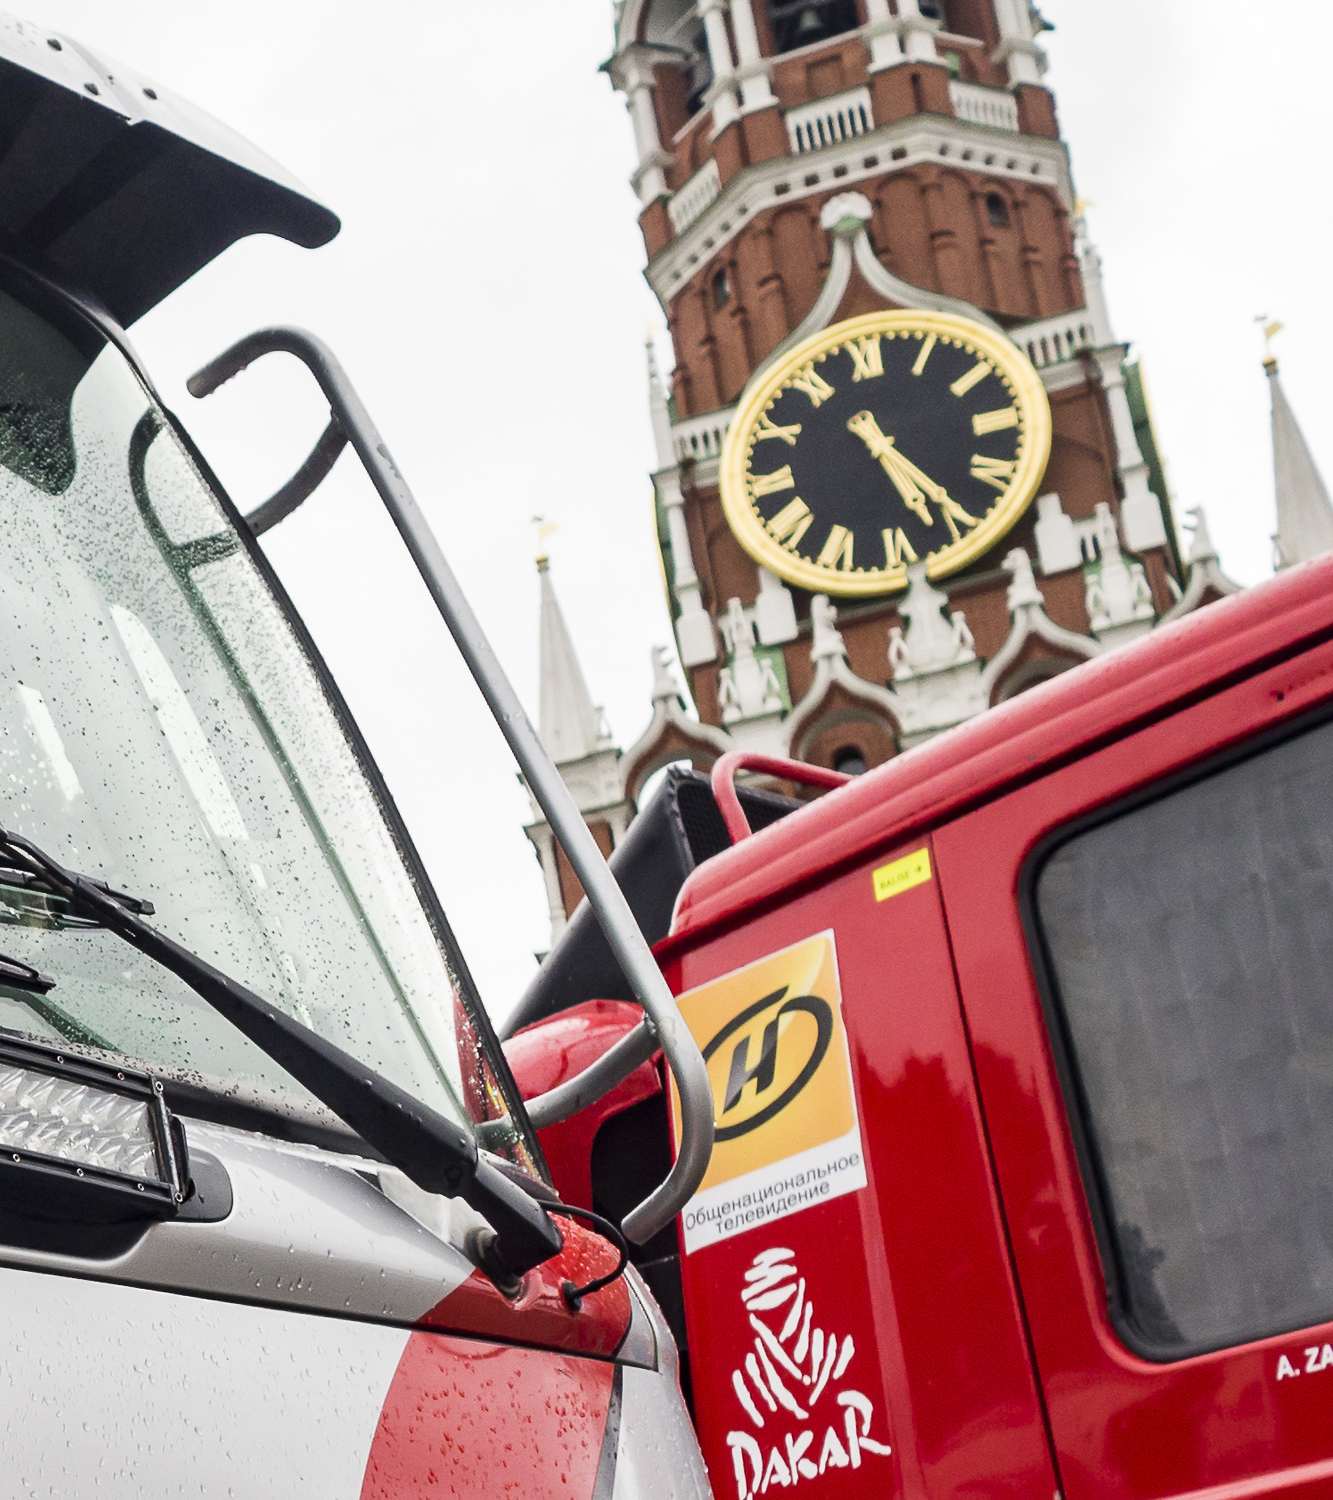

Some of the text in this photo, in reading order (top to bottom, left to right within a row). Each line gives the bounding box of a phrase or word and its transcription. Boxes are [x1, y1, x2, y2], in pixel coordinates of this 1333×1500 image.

[685, 1152, 860, 1231] Общенациональное
[715, 1181, 830, 1234] телевидение
[1276, 1354, 1300, 1381] A.
